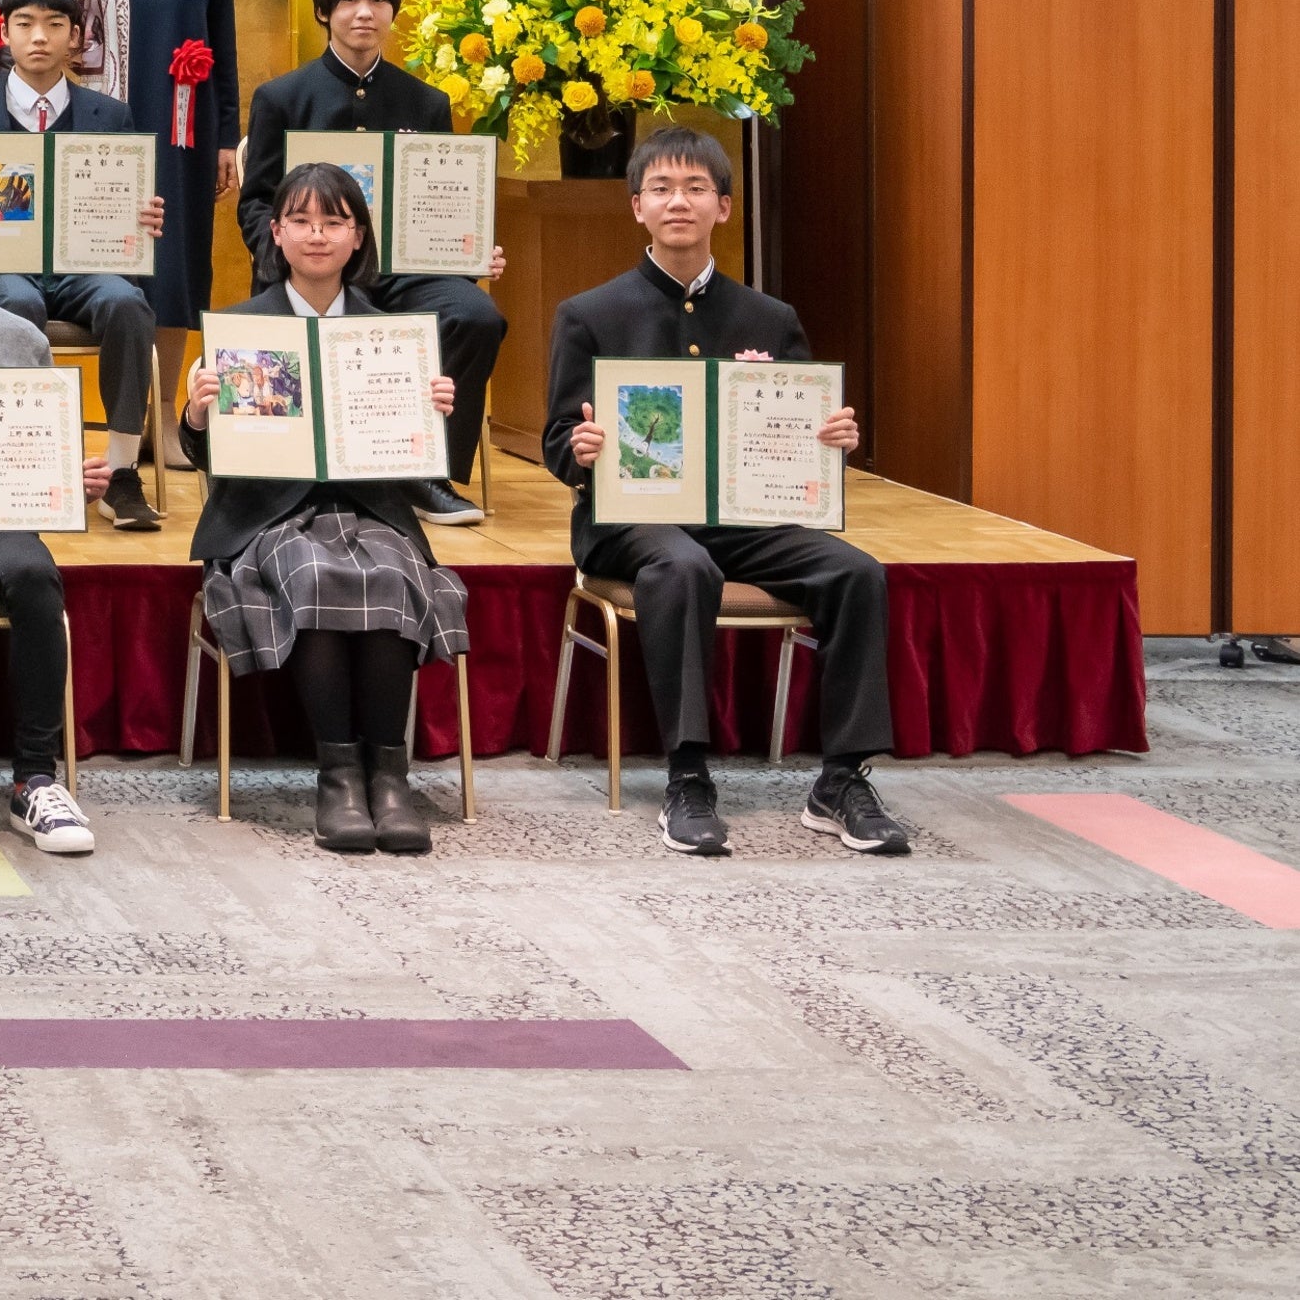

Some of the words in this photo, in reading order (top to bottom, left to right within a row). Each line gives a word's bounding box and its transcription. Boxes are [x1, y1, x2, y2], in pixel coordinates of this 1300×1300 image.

[354, 346, 403, 357] 表彰状
[755, 389, 805, 400] 表彰状
